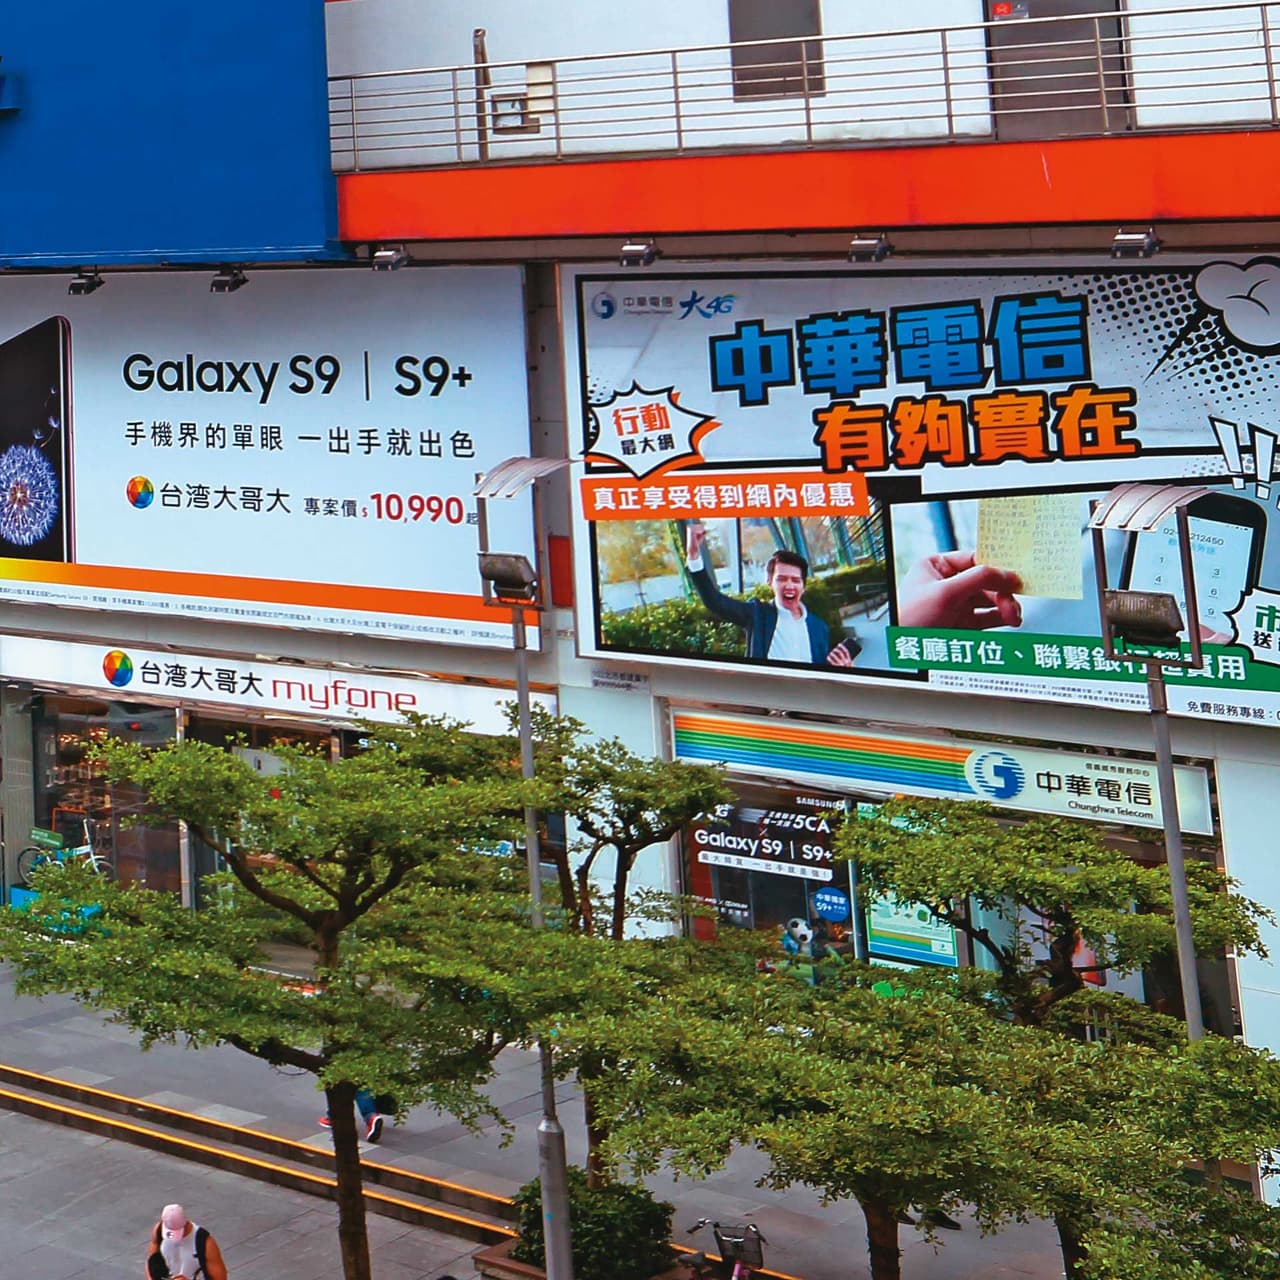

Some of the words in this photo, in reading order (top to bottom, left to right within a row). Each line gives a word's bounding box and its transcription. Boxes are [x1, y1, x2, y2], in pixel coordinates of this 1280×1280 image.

[710, 292, 1092, 407] 中華電信
[123, 353, 280, 404] Galaxy
[289, 354, 341, 395] S9
[394, 355, 473, 397] S9+
[612, 403, 671, 436] 行動
[815, 383, 1143, 474] 有夠實在
[124, 421, 284, 451] 手機界的單眼
[298, 426, 475, 458] 一出手就出色
[621, 434, 675, 455] 最大網
[304, 497, 357, 518] 專案價
[594, 482, 856, 512] 真正享受得到網內優惠
[272, 679, 416, 712] myfone
[1036, 771, 1152, 806] 中華電信
[793, 815, 831, 834] 5CA
[1068, 800, 1115, 814] Chunghwa
[1116, 806, 1154, 820] Telecom
[695, 829, 758, 857] Galaxy
[762, 839, 783, 855] S9
